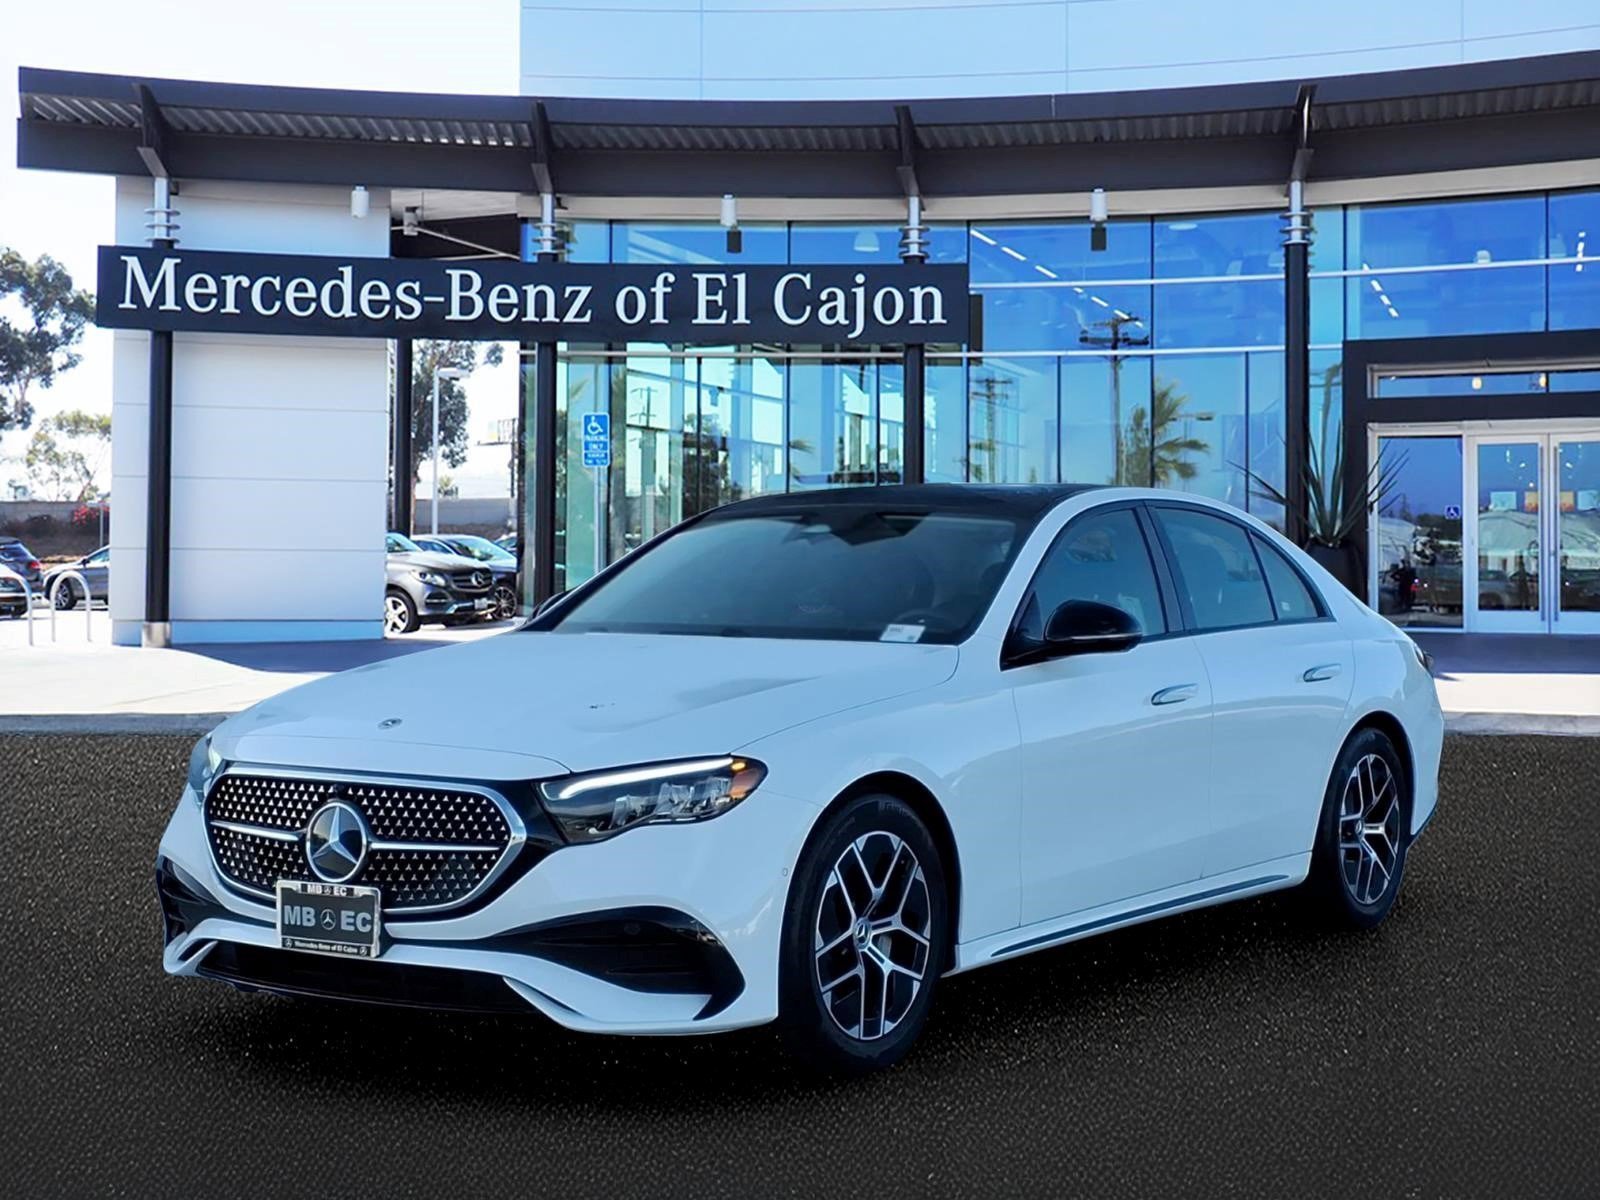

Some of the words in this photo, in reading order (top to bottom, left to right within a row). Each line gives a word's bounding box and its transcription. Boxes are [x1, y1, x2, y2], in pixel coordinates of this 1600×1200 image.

[118, 254, 593, 325] Mercedes-Benz
[615, 272, 676, 325] of
[691, 272, 751, 326] El
[773, 272, 948, 339] Cajon
[333, 886, 347, 897] EC
[283, 904, 316, 927] MB
[340, 910, 372, 933] EC
